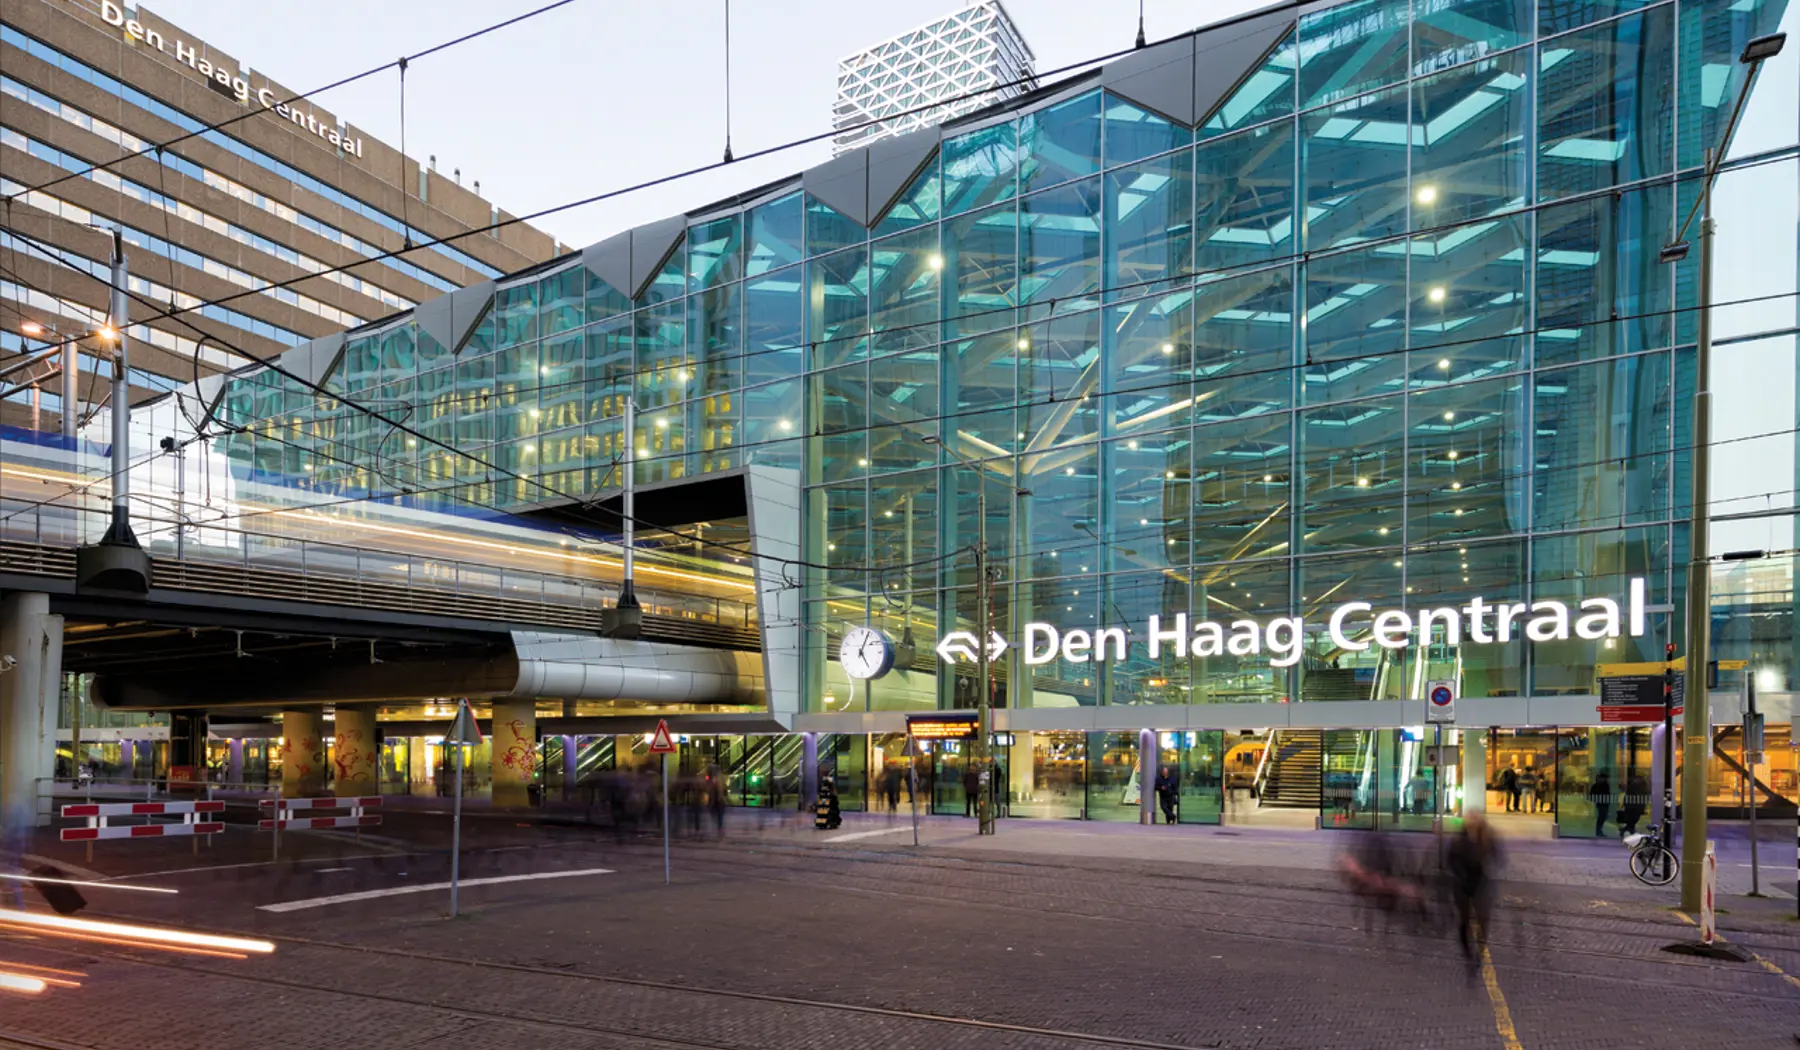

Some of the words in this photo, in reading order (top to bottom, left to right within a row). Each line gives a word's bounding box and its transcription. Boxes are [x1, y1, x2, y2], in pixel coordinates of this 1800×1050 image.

[101, 0, 163, 51] Den
[175, 40, 248, 100] Haag
[258, 87, 363, 159] Centraal
[1024, 622, 1126, 665] Den
[1149, 613, 1303, 667] Haag
[1329, 577, 1645, 650] Centraal
